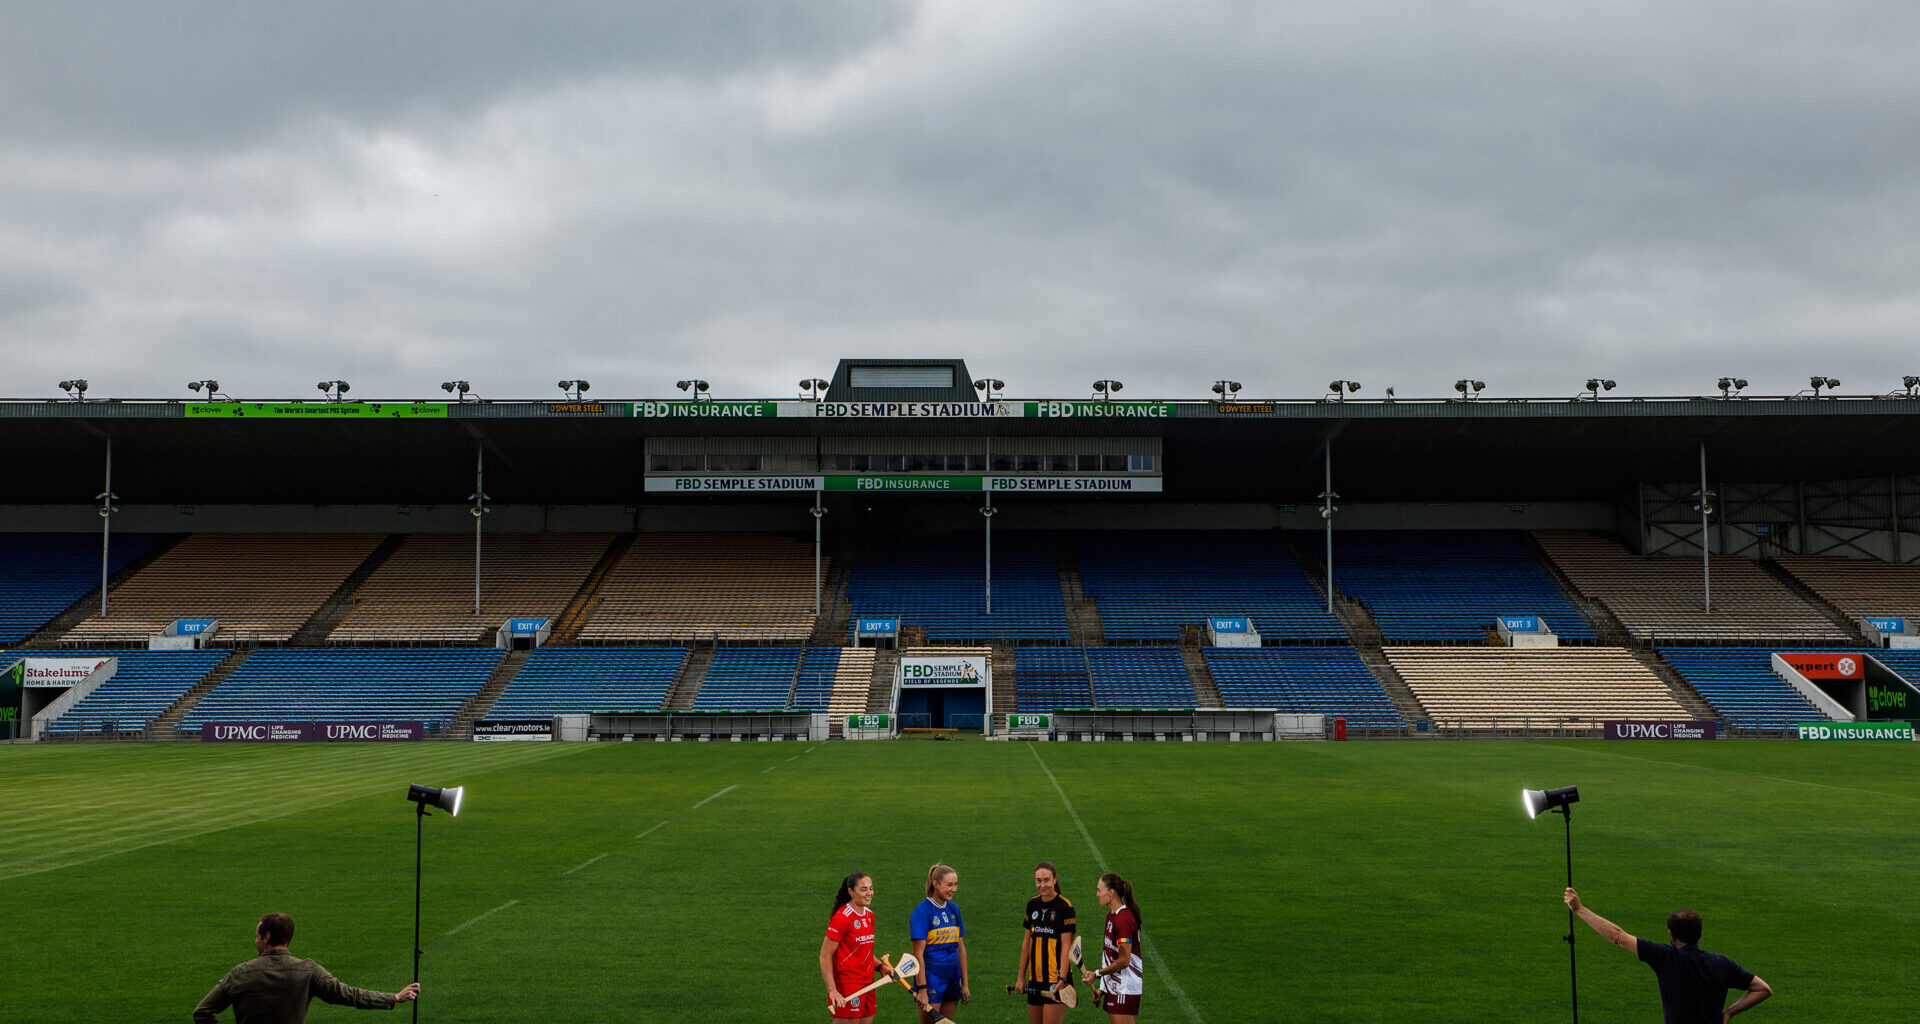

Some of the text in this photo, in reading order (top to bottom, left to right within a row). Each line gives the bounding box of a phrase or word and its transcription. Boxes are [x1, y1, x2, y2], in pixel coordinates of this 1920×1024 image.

[583, 405, 603, 413] STEEL
[633, 402, 763, 417] FBD INSURANCE
[816, 403, 995, 417] FBD SEMPLE STADIUM
[1037, 402, 1168, 417] FBD INSURANCE
[1252, 405, 1274, 413] STEEL
[675, 478, 815, 490] FBD SEMPLE STADIUM
[857, 478, 950, 489] FBD INSURANCE
[991, 478, 1132, 490] FBD SEMPLE STADIUM
[866, 622, 890, 630] EXIT 5
[1216, 621, 1240, 629] EXIT 4
[1507, 620, 1523, 628] EXIT
[1891, 621, 1896, 630] 2
[903, 664, 934, 678] FBD
[1791, 663, 1834, 671] xpert
[26, 668, 90, 678] Stakelums
[1878, 686, 1906, 708] clover
[858, 715, 880, 725] FBD
[1018, 715, 1040, 725] FBD
[214, 725, 266, 740] UPMC
[327, 725, 377, 739] UPMC
[475, 724, 551, 734] www.clearymotors.ie
[1616, 724, 1668, 738] UPMC
[1799, 726, 1911, 740] FBD INSURANCE
